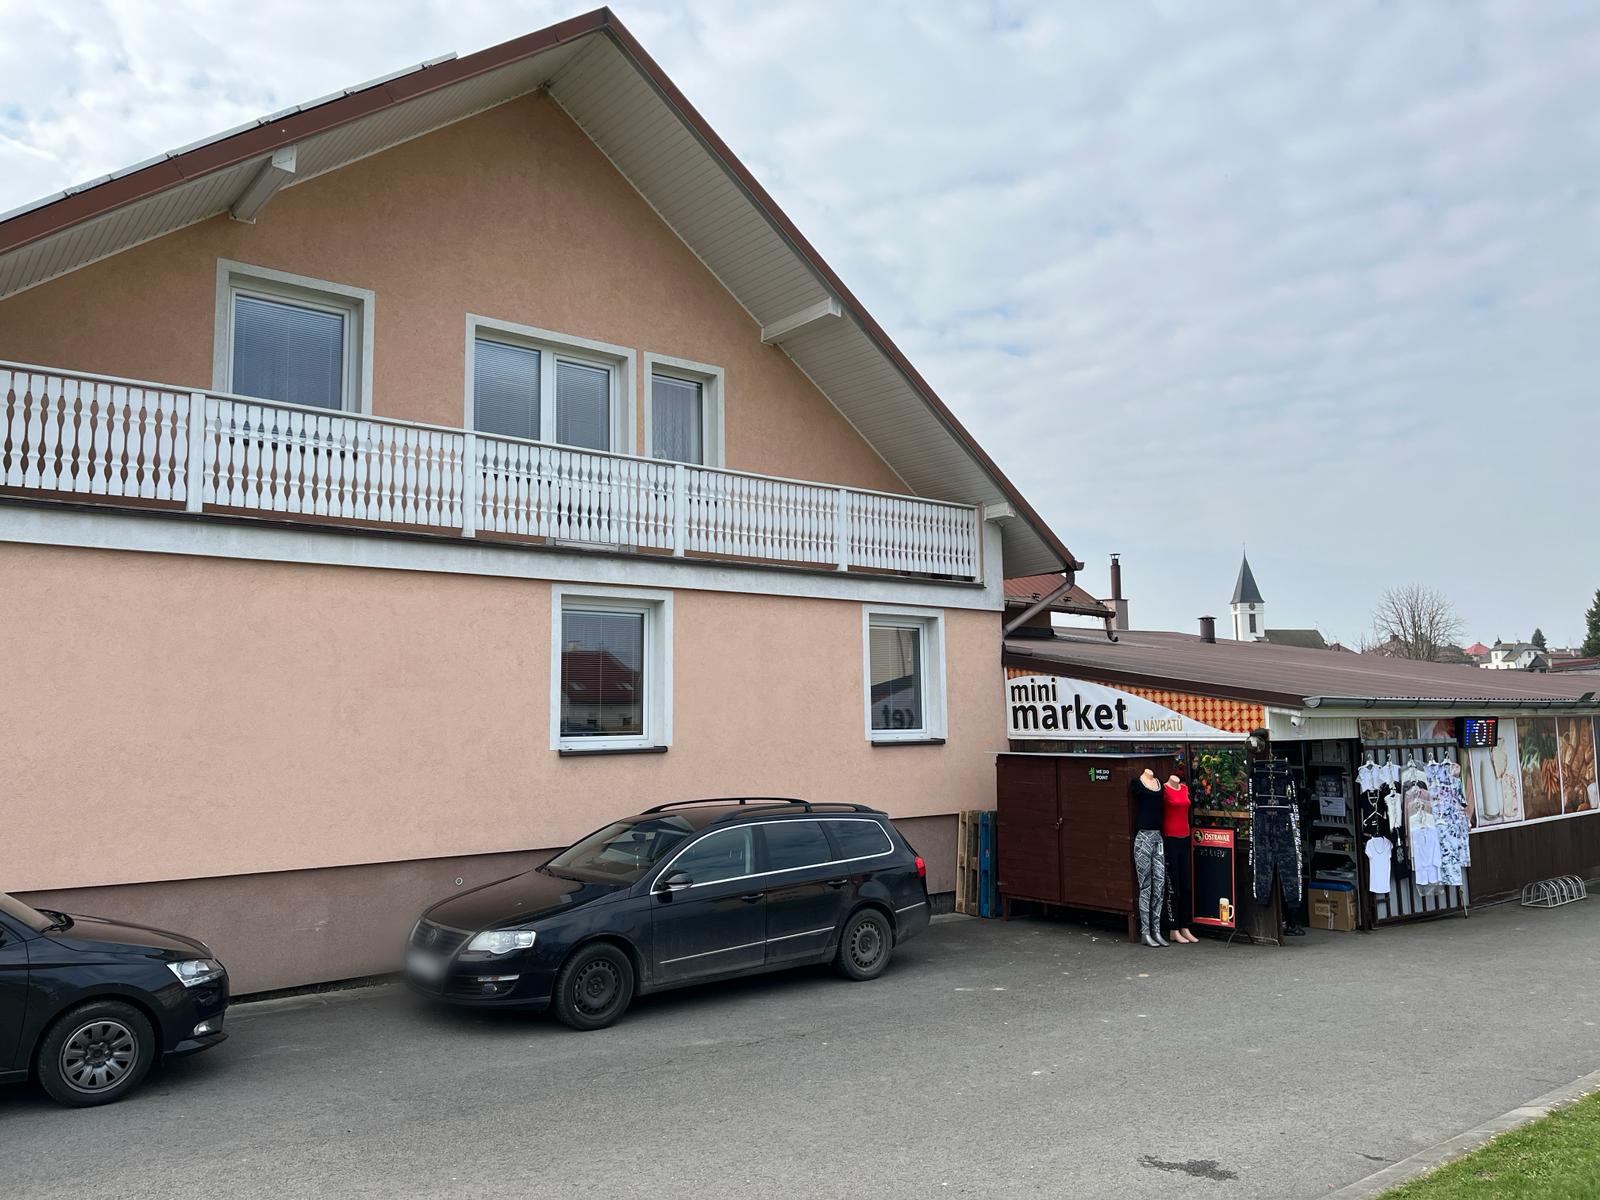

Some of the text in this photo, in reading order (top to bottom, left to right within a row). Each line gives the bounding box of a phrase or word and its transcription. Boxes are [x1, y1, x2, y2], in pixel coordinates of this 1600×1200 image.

[1010, 677, 1057, 702] mini
[1011, 694, 1129, 731] market
[1134, 715, 1183, 732] U NÁVRATŮ
